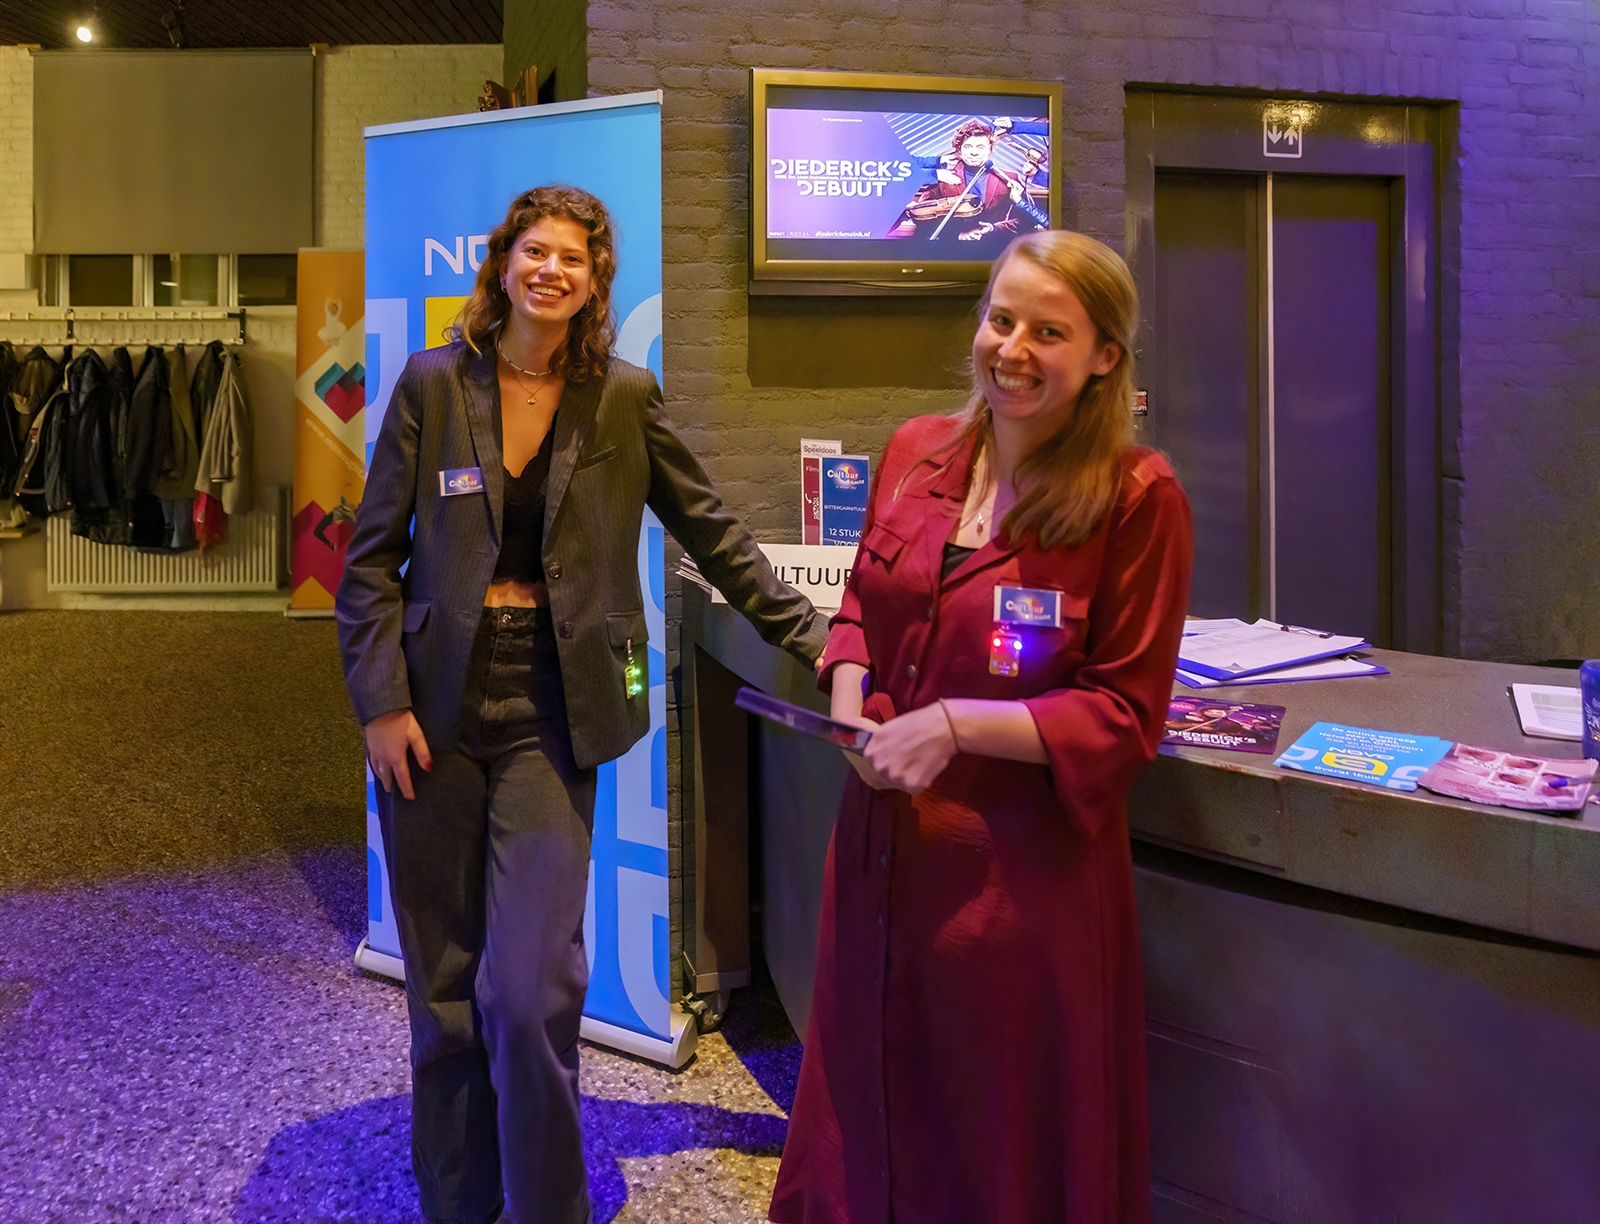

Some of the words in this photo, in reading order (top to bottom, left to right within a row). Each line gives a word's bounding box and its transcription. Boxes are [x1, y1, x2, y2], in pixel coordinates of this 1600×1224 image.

[771, 159, 912, 178] DIEDERICK'S
[797, 180, 887, 197] DEBUUT
[803, 445, 837, 454] Speeldoos
[827, 469, 859, 479] Cultuur
[824, 504, 867, 512] BITTERGARNITUUR
[829, 527, 838, 536] 12
[838, 528, 863, 538] STUK
[1346, 729, 1376, 738] online
[1378, 733, 1417, 744] omroep
[1328, 746, 1395, 760] NOVO
[1314, 765, 1349, 776] Overal
[1352, 769, 1381, 780] thuis
